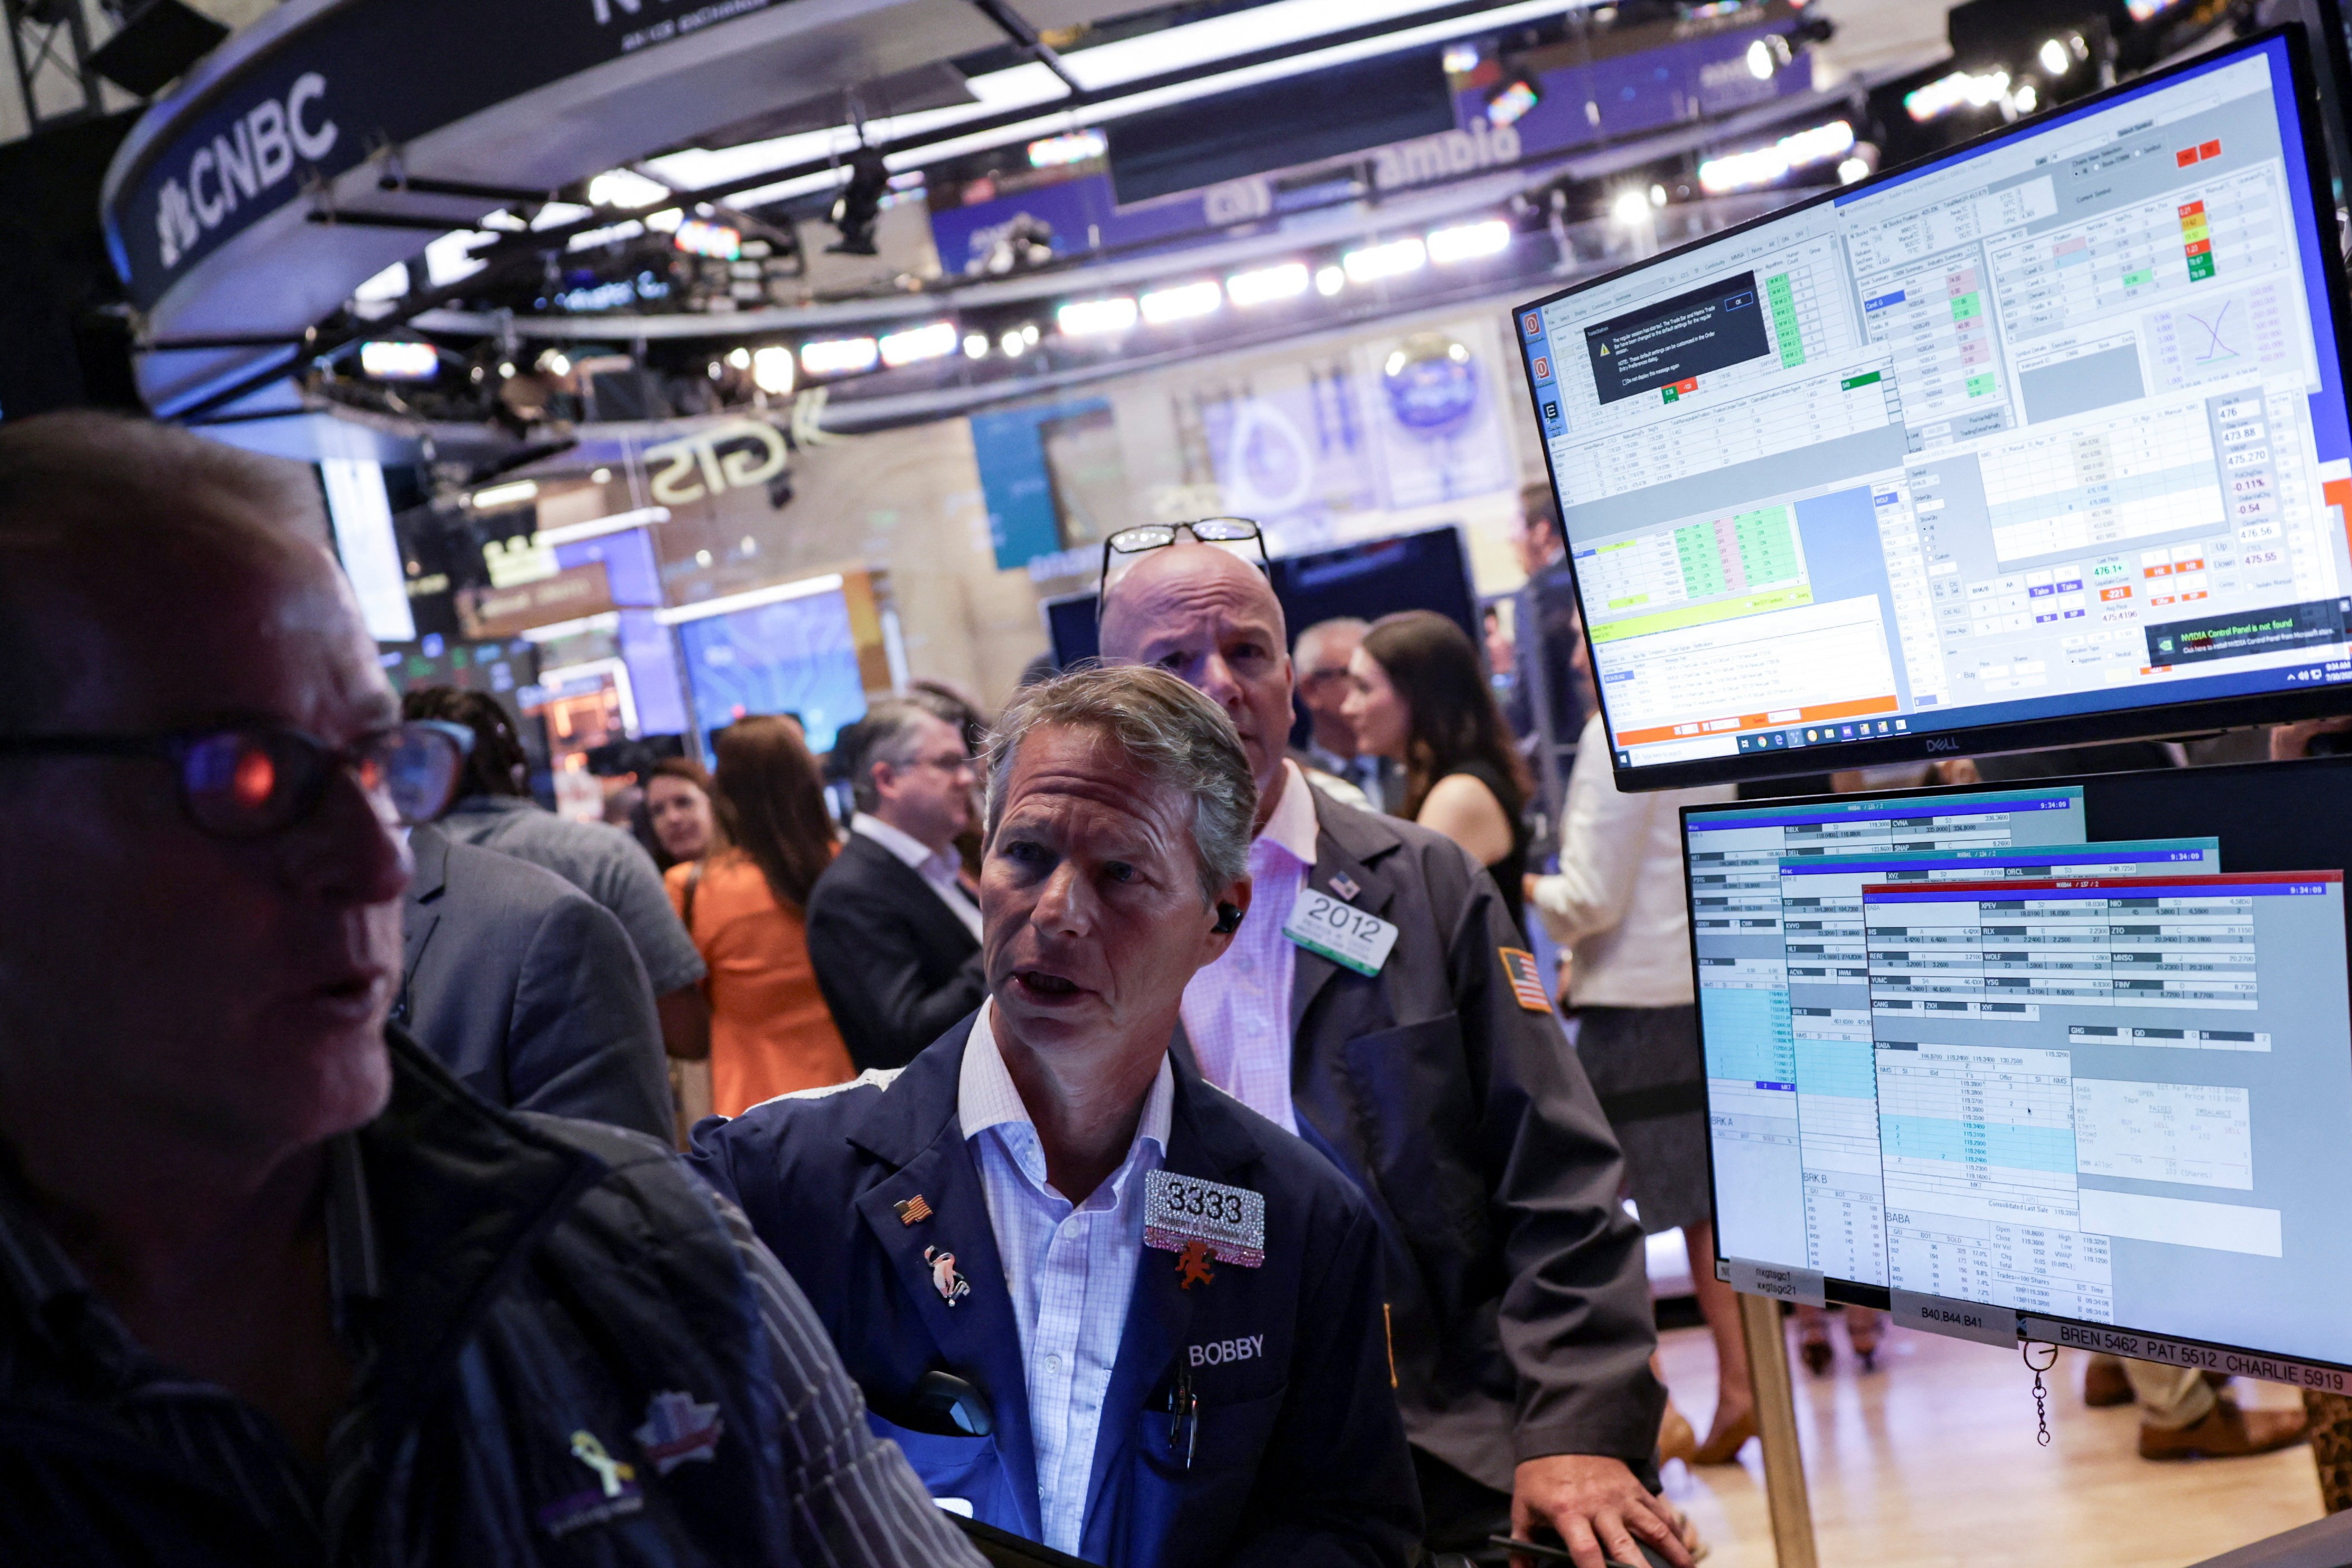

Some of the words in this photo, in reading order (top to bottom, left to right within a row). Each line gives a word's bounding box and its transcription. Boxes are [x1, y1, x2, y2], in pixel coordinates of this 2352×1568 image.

[189, 71, 338, 229] CNBC
[1619, 333, 1631, 342] regular
[1649, 322, 1663, 331] started.
[1705, 304, 1715, 313] Trade
[1637, 333, 1651, 342] changed
[1661, 325, 1674, 334] default
[1673, 321, 1687, 330] settings
[1699, 313, 1712, 322] regular
[1651, 347, 1665, 356] settings
[1676, 337, 1694, 348] customized
[1628, 359, 1647, 369] Preferences
[1637, 372, 1649, 381] display
[1655, 367, 1670, 375] message
[2219, 407, 2237, 419] 476
[2232, 478, 2265, 492] -0.11%
[2236, 503, 2260, 515] -0.54
[2241, 526, 2272, 540] 476.56
[2215, 542, 2228, 552] Up
[2185, 561, 2196, 570] Hit
[2213, 558, 2235, 569] Down
[2245, 551, 2276, 566] 475.55
[2093, 564, 2123, 576] 476.1+
[2153, 567, 2165, 576] Hit
[2033, 586, 2050, 596] Take
[2061, 581, 2078, 591] Take
[2105, 589, 2125, 599] -221
[2102, 609, 2138, 623] 475.4196
[2180, 630, 2206, 642] NVIDIA
[2208, 626, 2232, 639] Control
[2232, 623, 2251, 635] Panel
[2251, 623, 2257, 632] is
[2259, 622, 2270, 631] not
[2272, 617, 2293, 629] found
[1926, 737, 1959, 752] DELL
[1308, 898, 1381, 943] 2012
[2135, 1029, 2146, 1037] QD
[1804, 1173, 1819, 1182] BRK
[1821, 1175, 1827, 1183] B
[1167, 1182, 1241, 1224] 3333
[1989, 1201, 2023, 1210] Consolidated
[1886, 1213, 1910, 1224] BABA
[1159, 1216, 1190, 1229] ROBERT
[1203, 1225, 1240, 1239] CHARMAK
[1922, 1307, 1982, 1328] B40,B44,B41
[1189, 1334, 1264, 1367] BOBBY
[2061, 1326, 2100, 1345] BREN
[2105, 1334, 2138, 1353] 5462
[2147, 1341, 2176, 1359] PAT
[2181, 1348, 2216, 1367] 5512
[2227, 1356, 2298, 1381] CHARLIE
[2304, 1370, 2343, 1389] 5919
